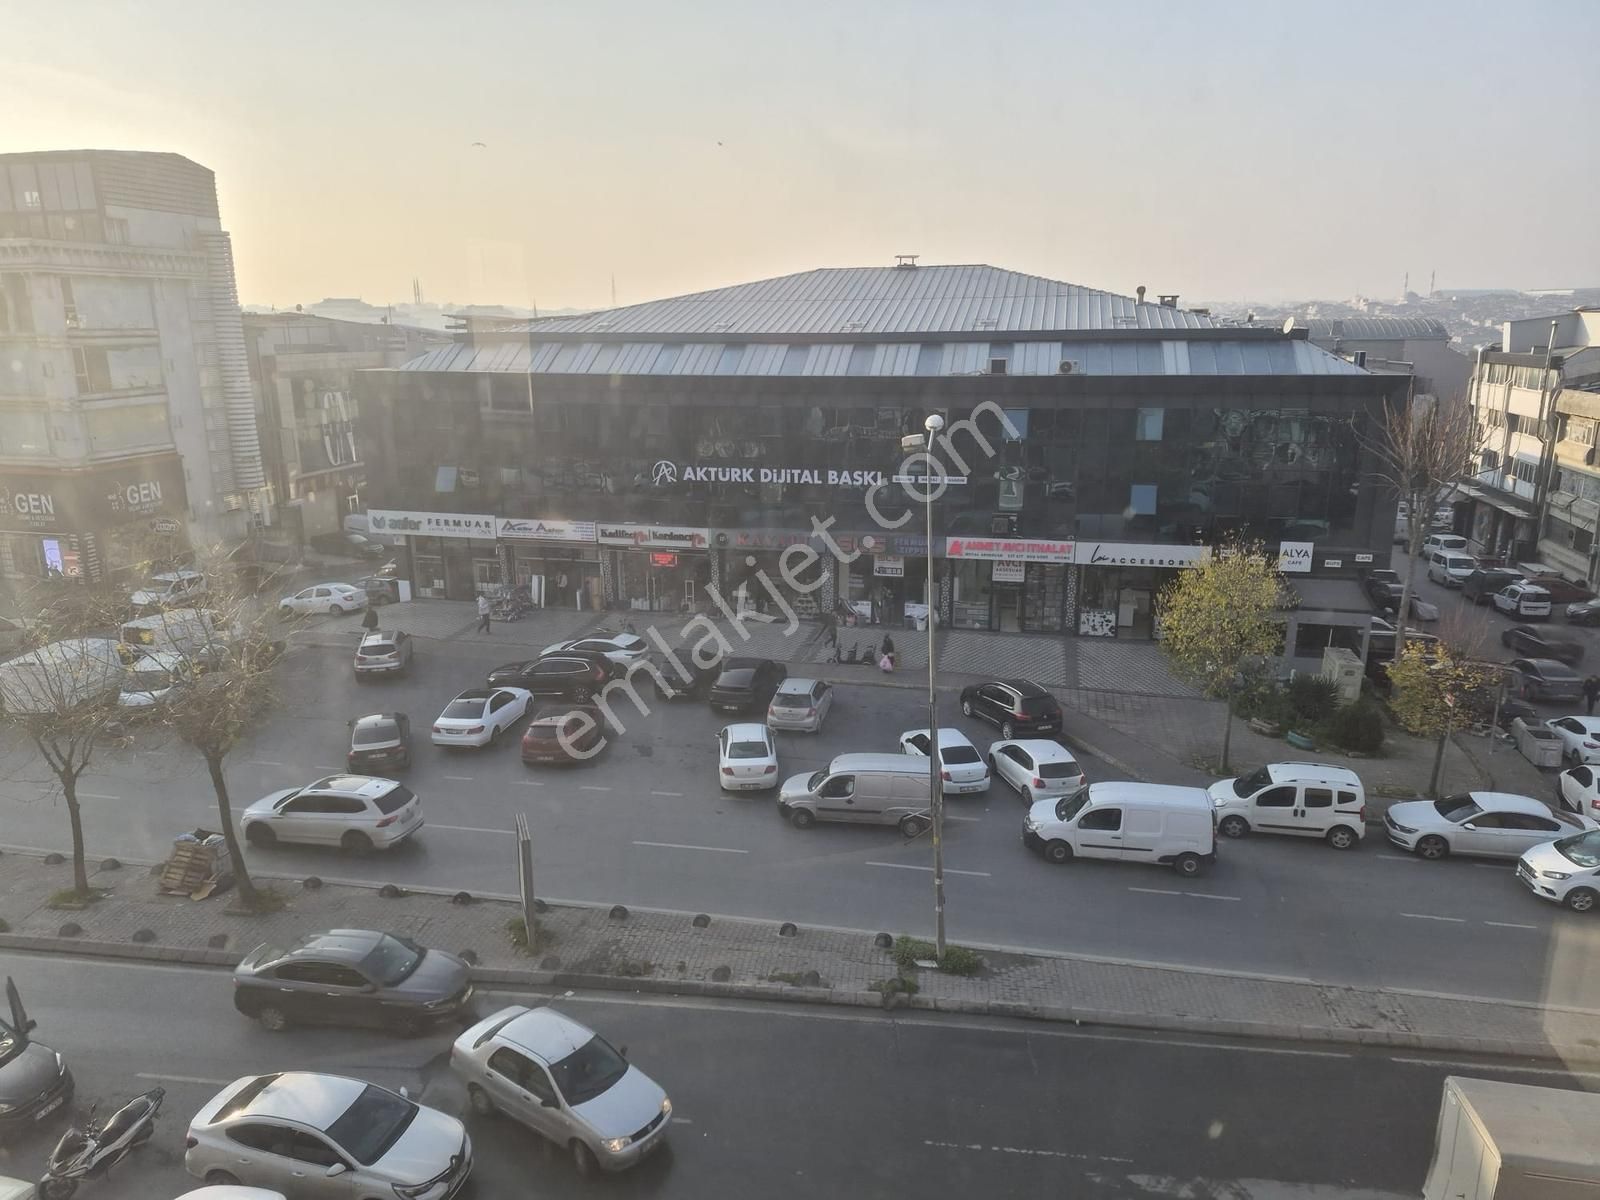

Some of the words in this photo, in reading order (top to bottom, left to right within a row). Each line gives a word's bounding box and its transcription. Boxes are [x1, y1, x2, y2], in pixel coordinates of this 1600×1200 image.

[683, 466, 754, 482] AKTÜRK
[828, 469, 882, 486] BASKI
[126, 480, 162, 505] GEN
[14, 492, 54, 514] GEN
[427, 518, 491, 529] FERMUAR
[1282, 547, 1310, 559] ALYA
[1111, 557, 1194, 566] ACCESSORY
